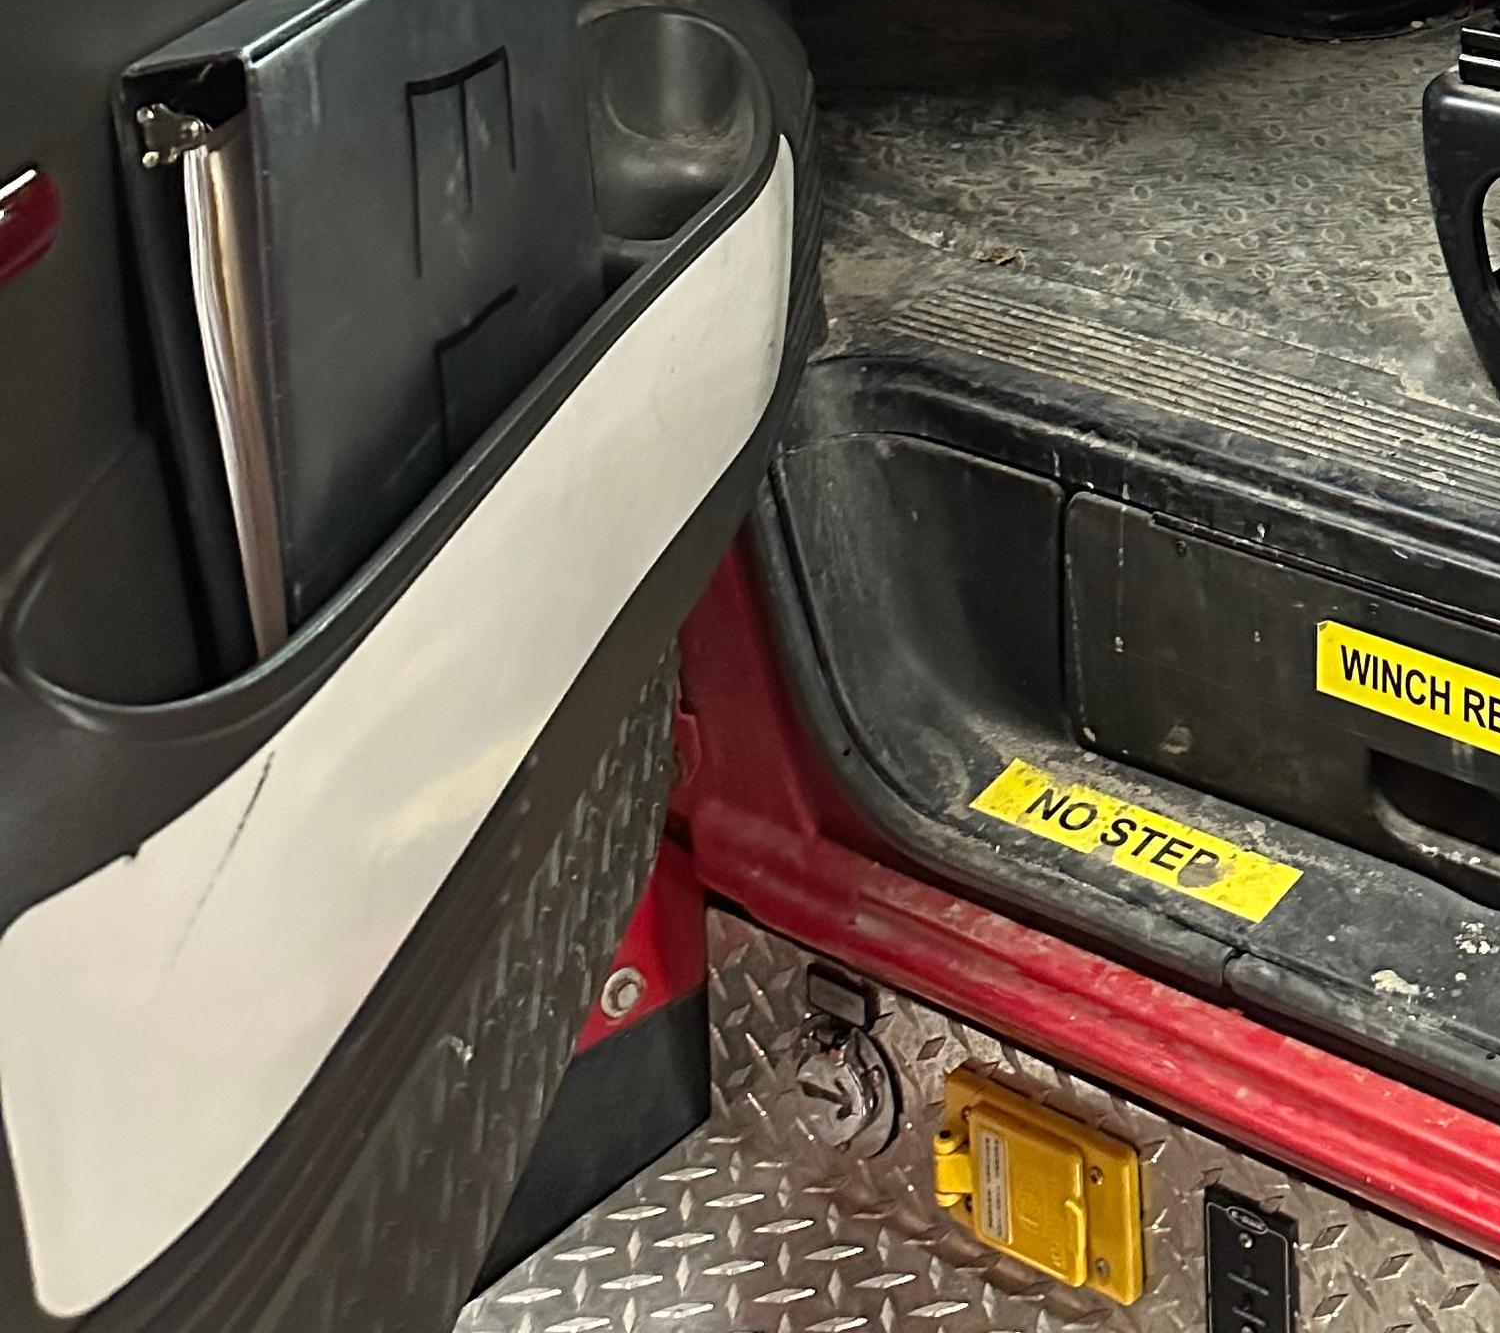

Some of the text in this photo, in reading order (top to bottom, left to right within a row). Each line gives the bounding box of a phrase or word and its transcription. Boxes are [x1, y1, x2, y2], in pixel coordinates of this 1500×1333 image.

[1341, 644, 1450, 715] WINCH
[1024, 788, 1220, 874] NO STEP
